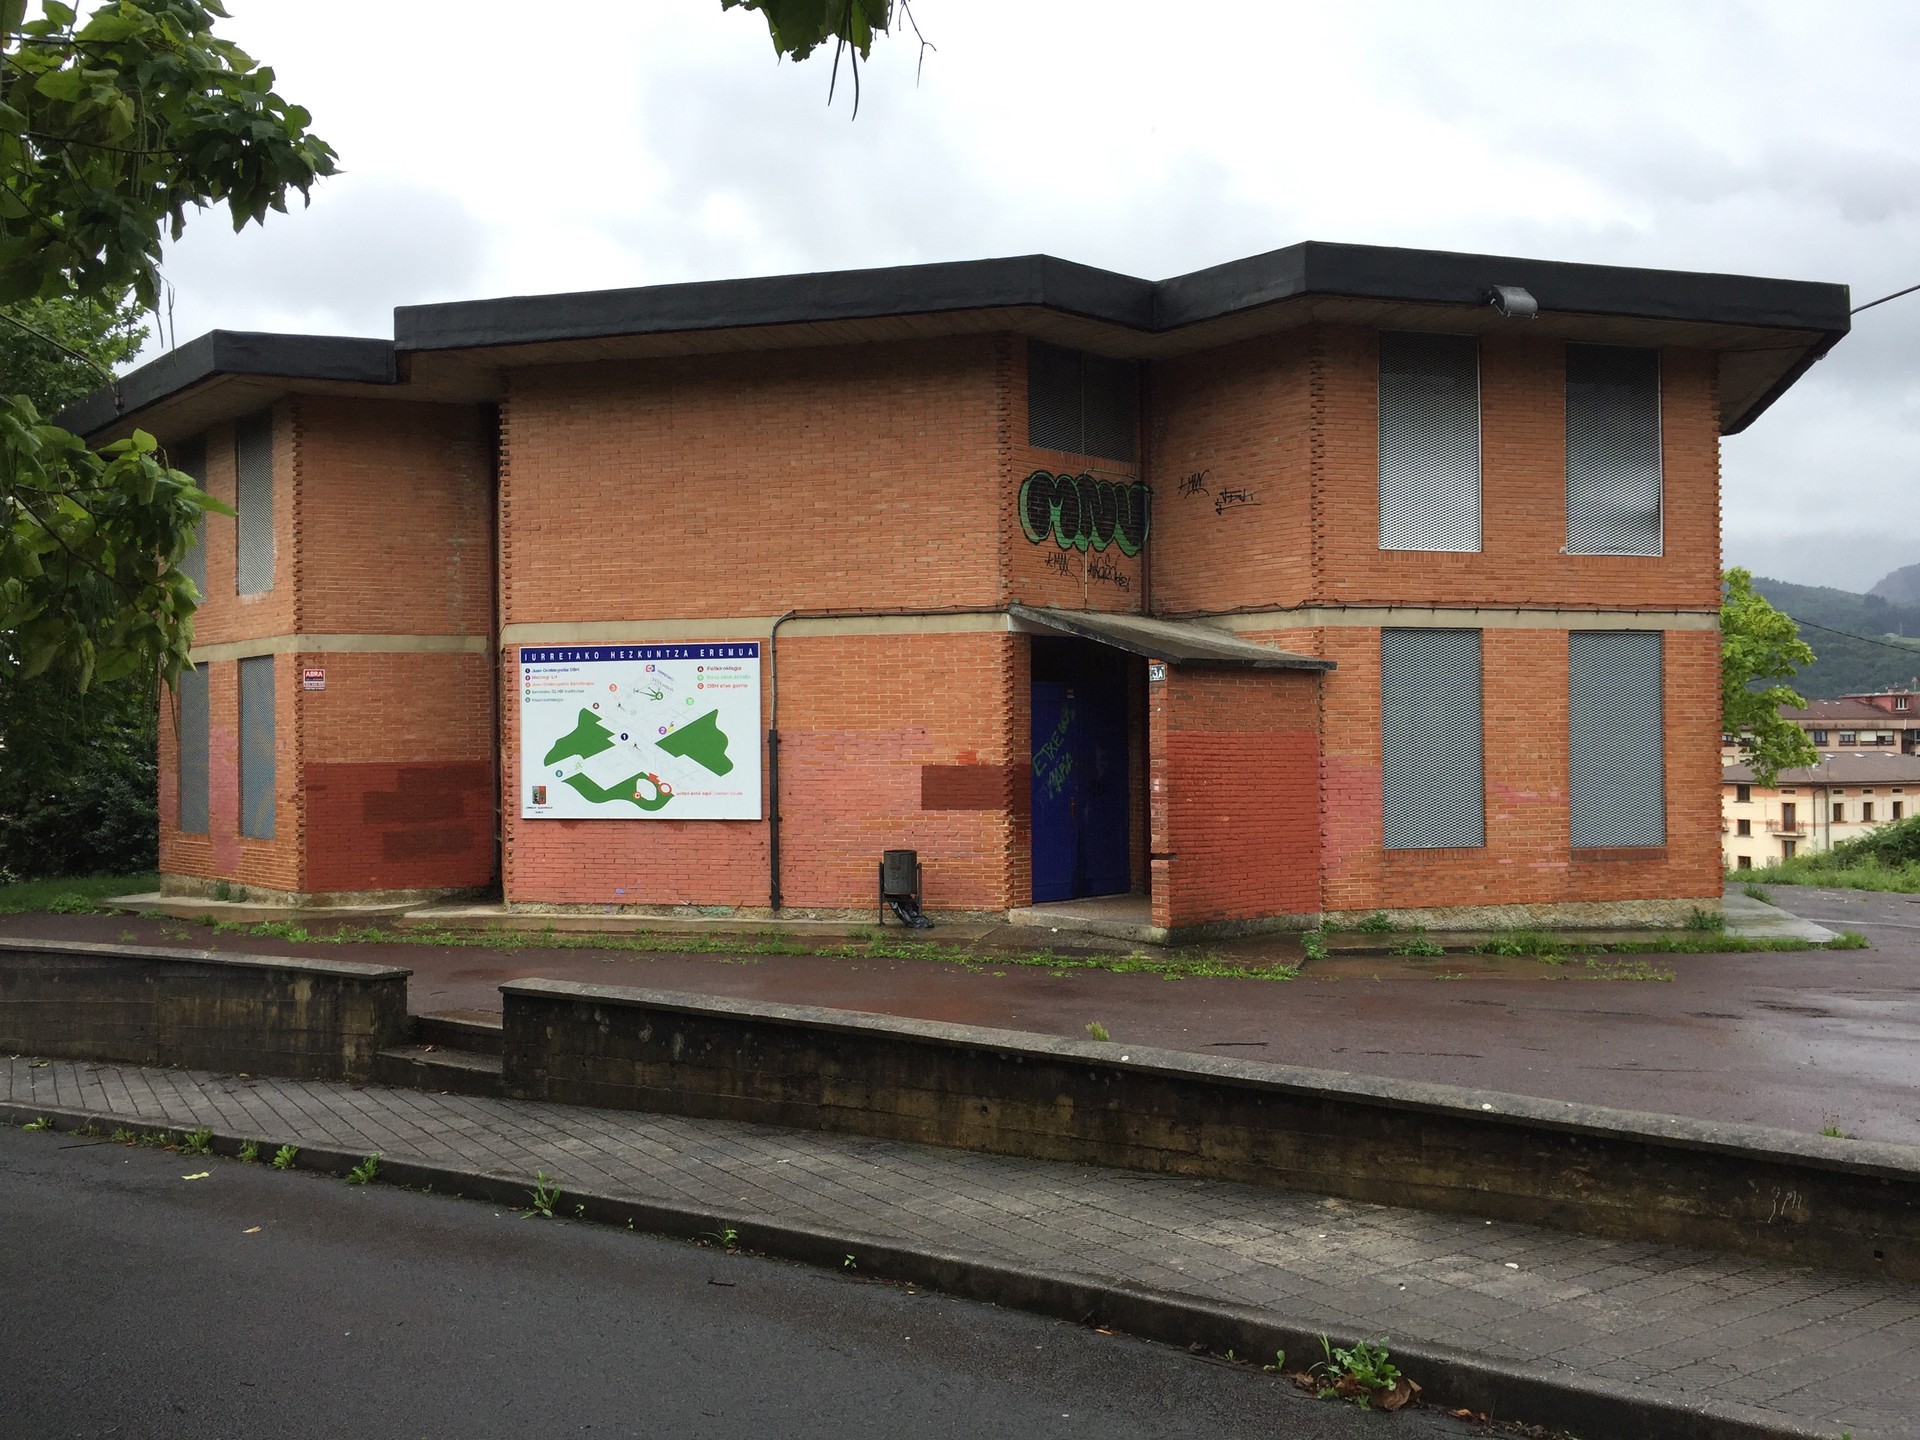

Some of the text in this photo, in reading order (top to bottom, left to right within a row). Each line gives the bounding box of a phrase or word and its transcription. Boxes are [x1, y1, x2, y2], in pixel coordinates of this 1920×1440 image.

[524, 648, 753, 661] IURRETAKO HEZKUNTZA EREMUA
